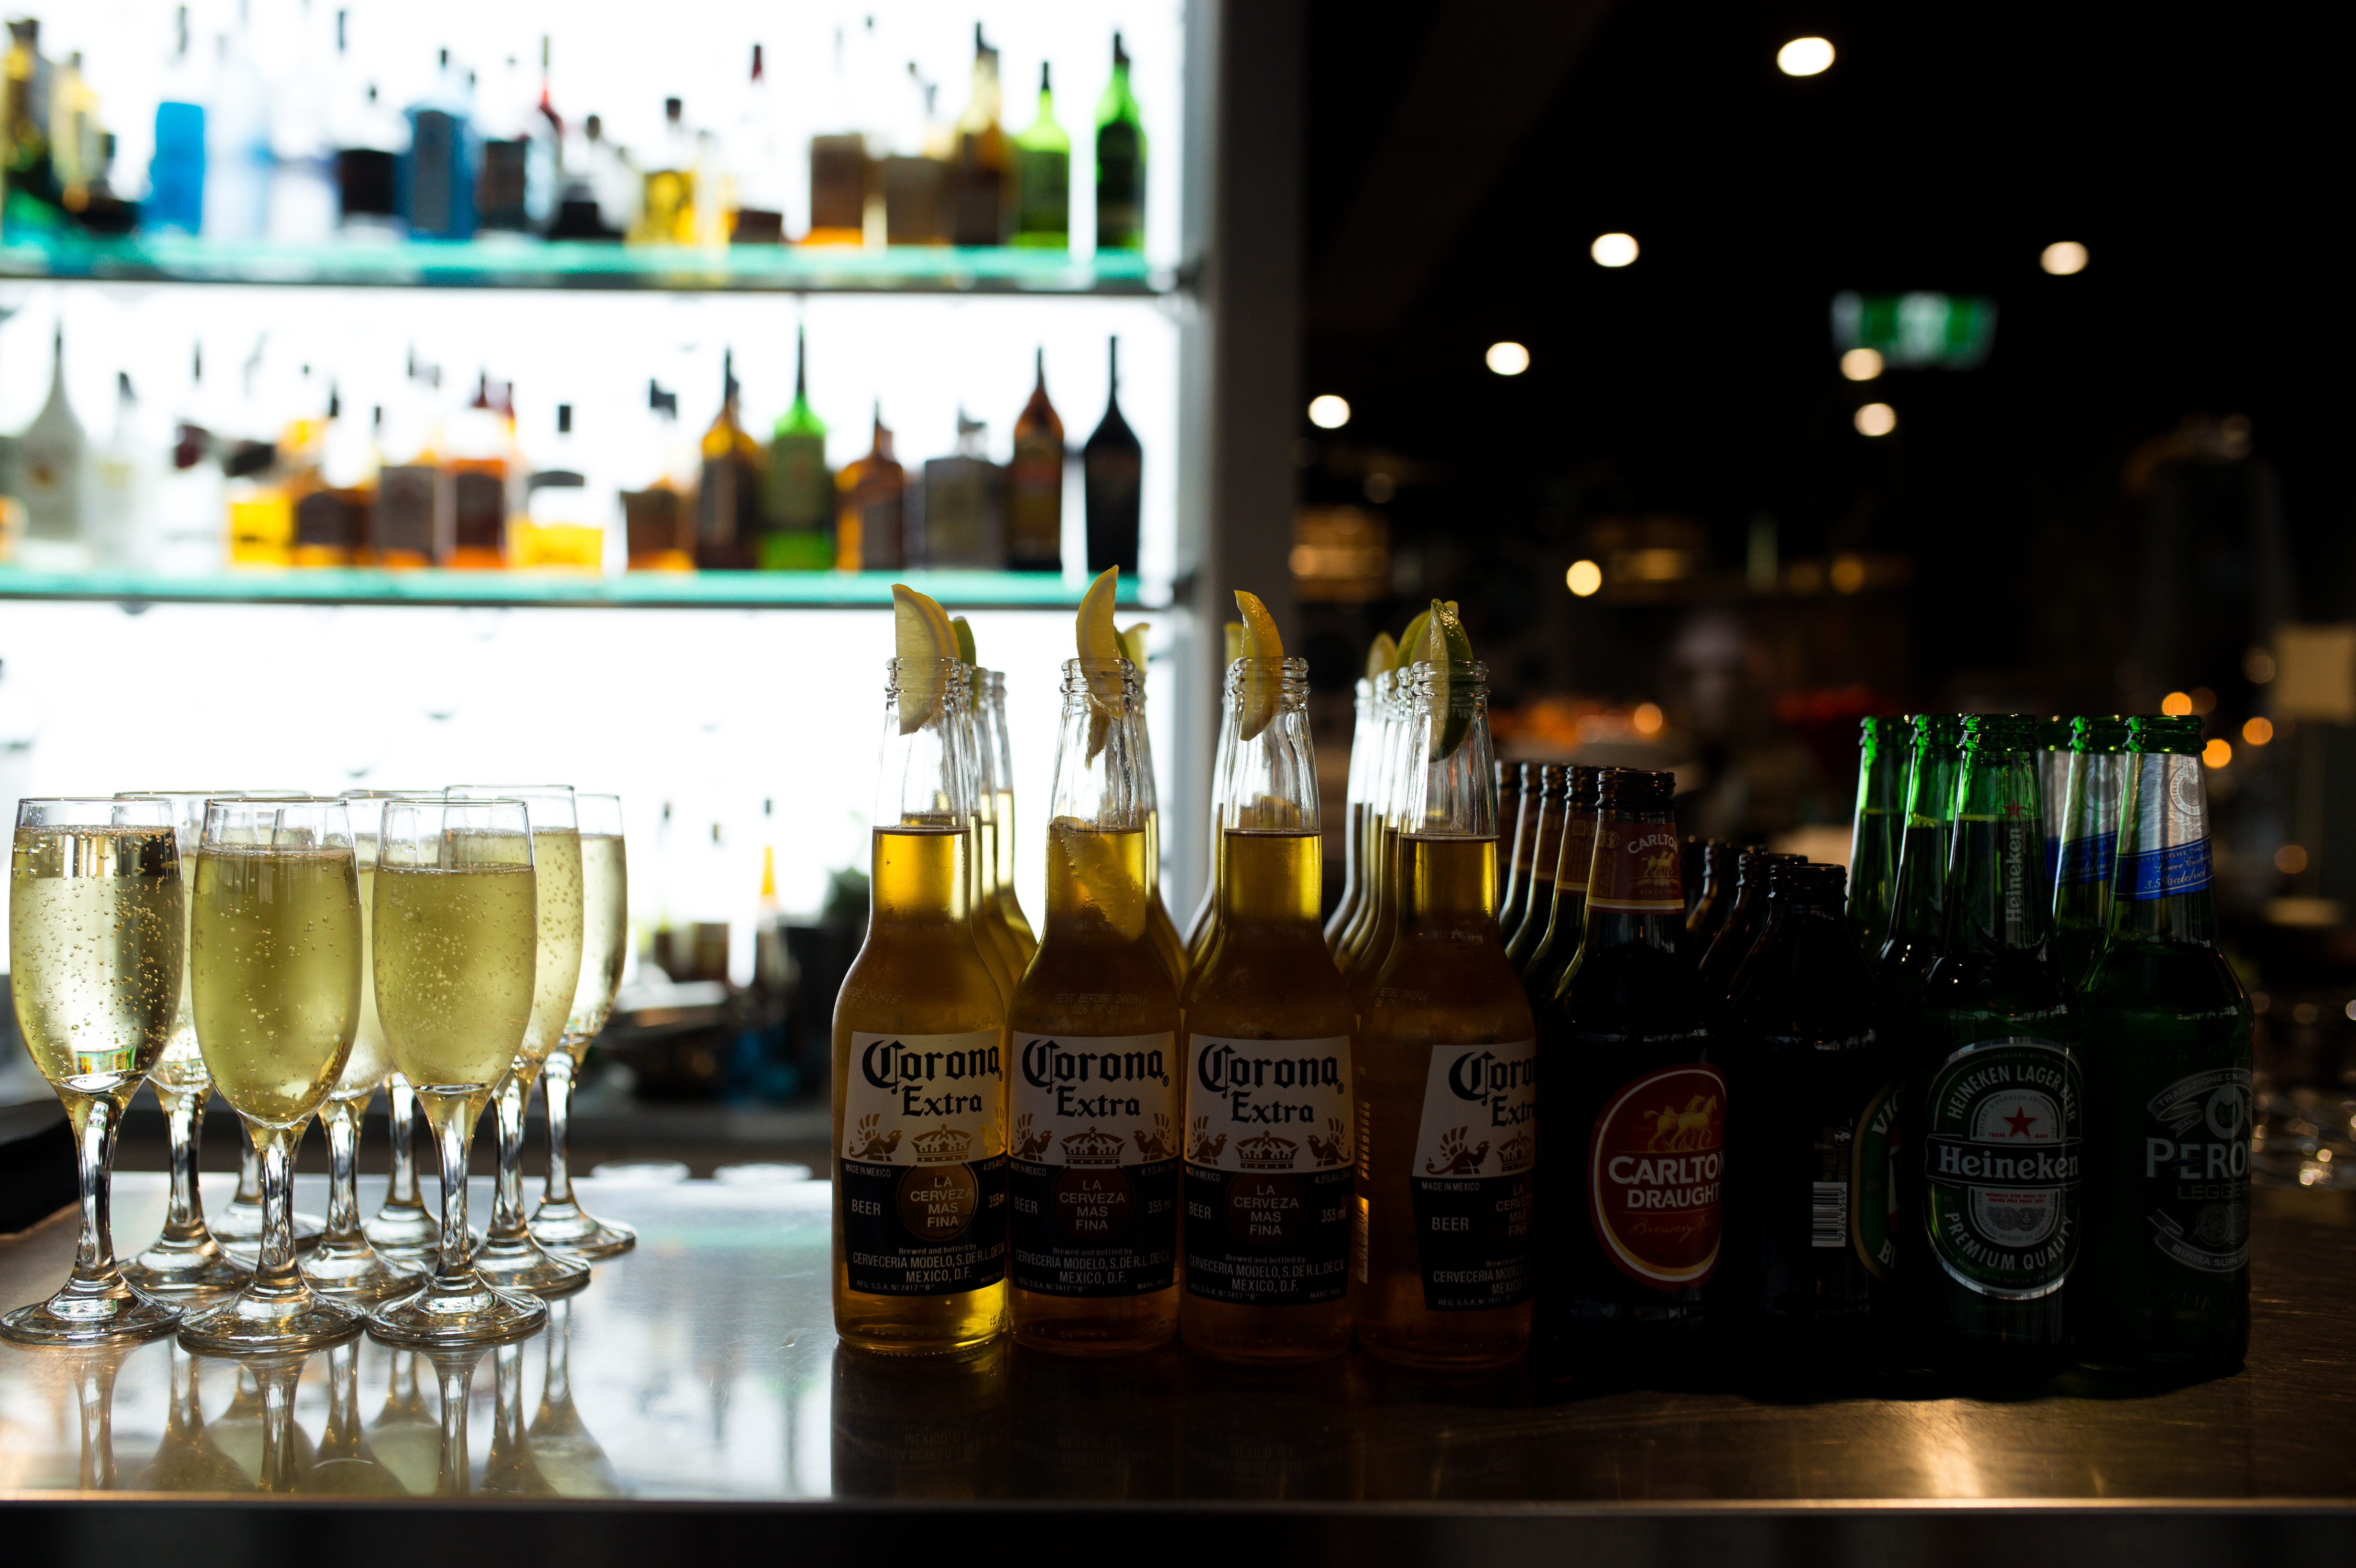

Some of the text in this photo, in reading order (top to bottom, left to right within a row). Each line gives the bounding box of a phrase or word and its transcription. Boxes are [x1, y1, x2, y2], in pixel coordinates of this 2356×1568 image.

[1627, 834, 1678, 854] CARLTON
[2005, 828, 2022, 922] Heineken
[2154, 862, 2184, 873] Lower
[1992, 1052, 2050, 1061] ORIGINAL RECIPE
[862, 1040, 1000, 1095] Corona
[1022, 1039, 1165, 1094] Corona
[1199, 1044, 1340, 1099] Corona
[1947, 1065, 2011, 1120] HEINEKEN
[2017, 1065, 2062, 1091] LAGER
[2059, 1083, 2076, 1122] BEER
[2157, 1075, 2224, 1107] TRADIZIONE
[901, 1085, 982, 1116] Extra
[1056, 1085, 1141, 1117] Extra
[1231, 1090, 1314, 1124] Extra
[2176, 1117, 2195, 1132] DAL
[1011, 1161, 1046, 1176] MADE IN MEXICO
[1608, 1148, 1725, 1186] CARLTON
[1938, 1144, 2079, 1180] Heineken
[846, 1164, 891, 1178] MADE IN MEXICO
[1186, 1165, 1220, 1182] MADE IN MEXICO
[1838, 1165, 1848, 1181] BEER
[934, 1176, 953, 1187] LA
[1083, 1180, 1102, 1190] LA
[1421, 1181, 1480, 1192] MADE IN MEXICO
[910, 1187, 973, 1202] CERVEZA
[1257, 1184, 1276, 1196] LA
[1513, 1183, 1524, 1196] LA
[1626, 1181, 1720, 1209] DRAUGHT
[988, 1193, 1000, 1209] 355
[1014, 1196, 1037, 1214] BEER
[1059, 1192, 1125, 1203] CERVEZA
[1234, 1197, 1299, 1209] CERVEZA
[851, 1199, 881, 1216] BEER
[928, 1202, 959, 1214] MAS
[1077, 1206, 1108, 1217] MAS
[1148, 1197, 1171, 1214] 355 ml
[1189, 1201, 1211, 1220] BEER
[927, 1216, 959, 1228] FINA
[1251, 1211, 1281, 1222] MAS
[1321, 1206, 1346, 1223] 355 ml
[1509, 1209, 1527, 1223] MAS
[1076, 1220, 1108, 1230] FINA
[1250, 1224, 1282, 1236] FINA
[1431, 1217, 1470, 1231] BEER
[1508, 1222, 1527, 1237] FINA
[1628, 1217, 1695, 1243] Brewery
[928, 1246, 941, 1254] and
[944, 1244, 968, 1253] bottled
[969, 1243, 977, 1252] by
[1944, 1212, 2015, 1271] PREMIUM
[2022, 1215, 2073, 1270] QUALITY
[1053, 1247, 1133, 1256] Brewed and bottled by
[1225, 1253, 1306, 1263] Brewed and bottled by
[2171, 1244, 2211, 1266] BIRRA
[853, 1252, 976, 1269] CERVECERIA MODELO, S. DE
[1016, 1249, 1061, 1268] CERVECERIA
[1064, 1257, 1108, 1272] MODELO,
[1110, 1258, 1119, 1269] S.
[1120, 1256, 1132, 1268] DE
[1151, 1252, 1159, 1264] DE
[1189, 1253, 1233, 1275] CERVECERIA
[1236, 1264, 1281, 1280] MODELO,
[1282, 1266, 1291, 1277] S.
[1293, 1264, 1304, 1277] DE
[1324, 1261, 1333, 1274] DE
[1485, 1259, 1508, 1268] Brewed
[1509, 1256, 1518, 1264] and
[906, 1267, 971, 1283] MEXICO, D.F.
[1059, 1271, 1126, 1285] MEXICO, D.F.
[1433, 1270, 1493, 1284] CERVECERIA
[1984, 1274, 2000, 1282] WITH
[1137, 1281, 1156, 1290] MARC.
[1232, 1278, 1299, 1294] MEXICO, D.F.
[1492, 1278, 1523, 1296] MEXICO,
[1227, 1291, 1243, 1299] 7417
[1310, 1290, 1328, 1299] MARC.
[1487, 1295, 1502, 1305] 7417
